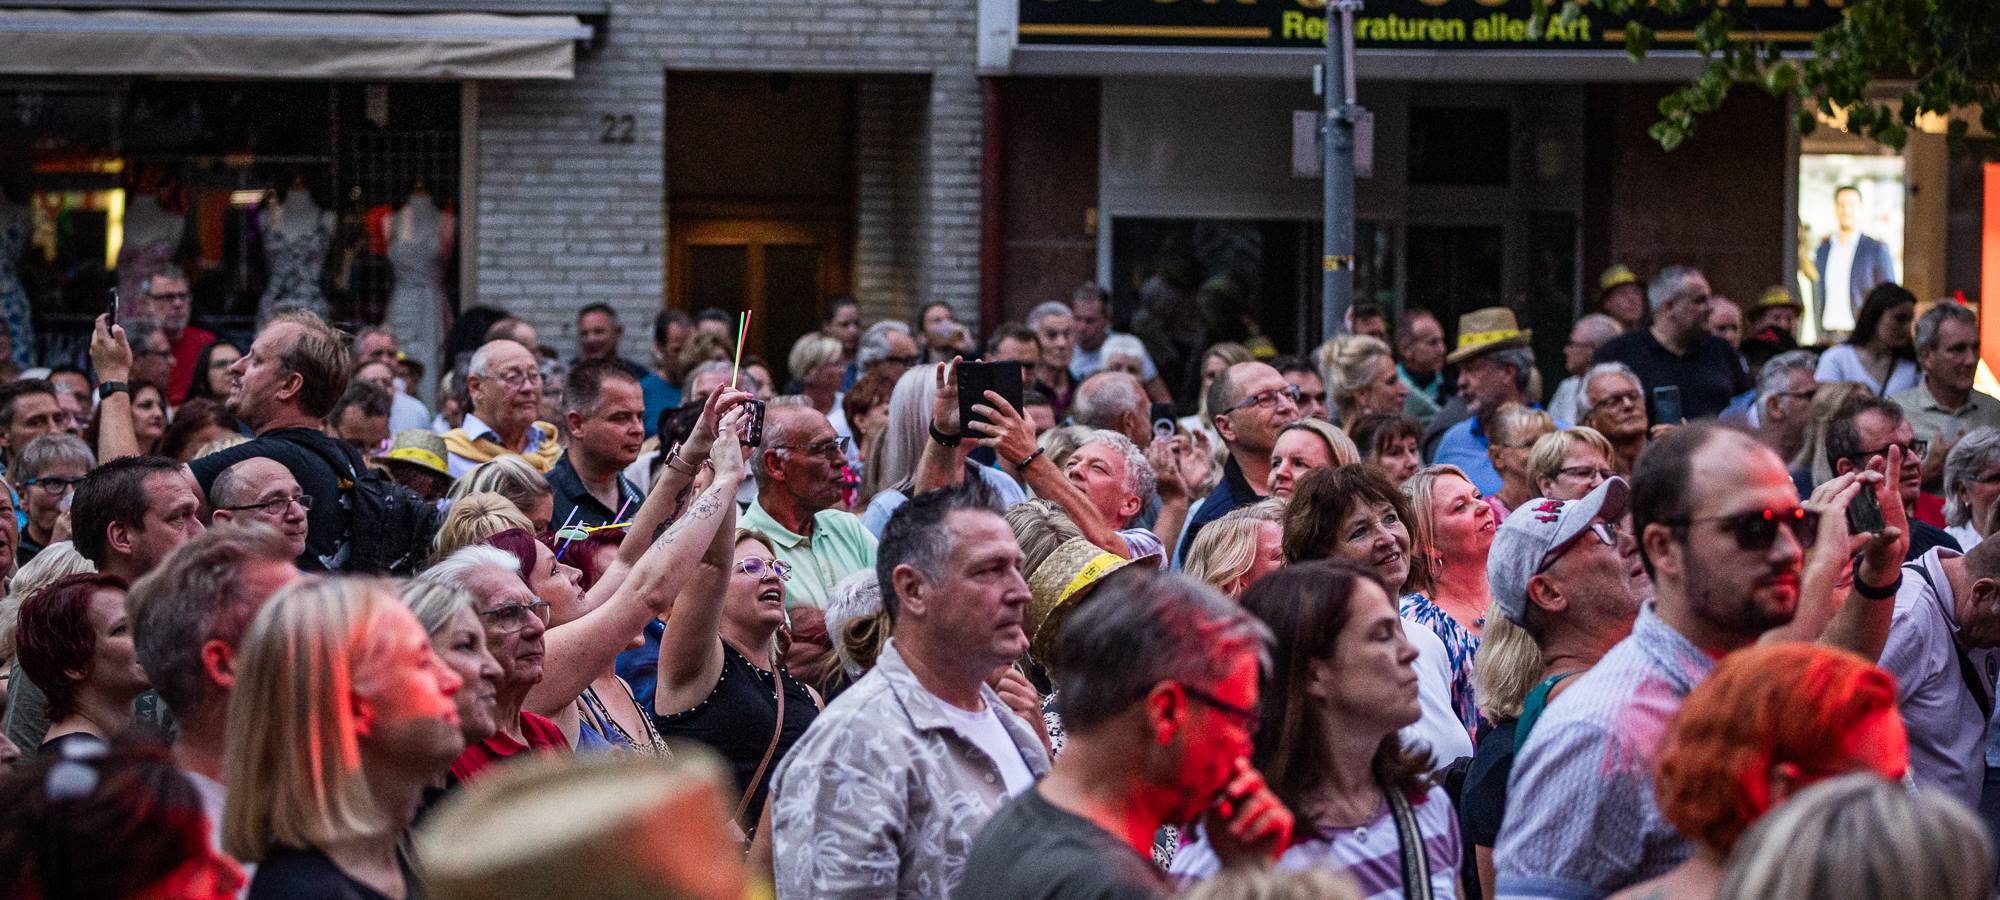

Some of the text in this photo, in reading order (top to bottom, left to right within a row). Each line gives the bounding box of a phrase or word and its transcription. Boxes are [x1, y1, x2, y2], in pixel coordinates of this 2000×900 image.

[1282, 10, 1591, 46] Reraturen alle Art
[601, 112, 636, 144] 22
